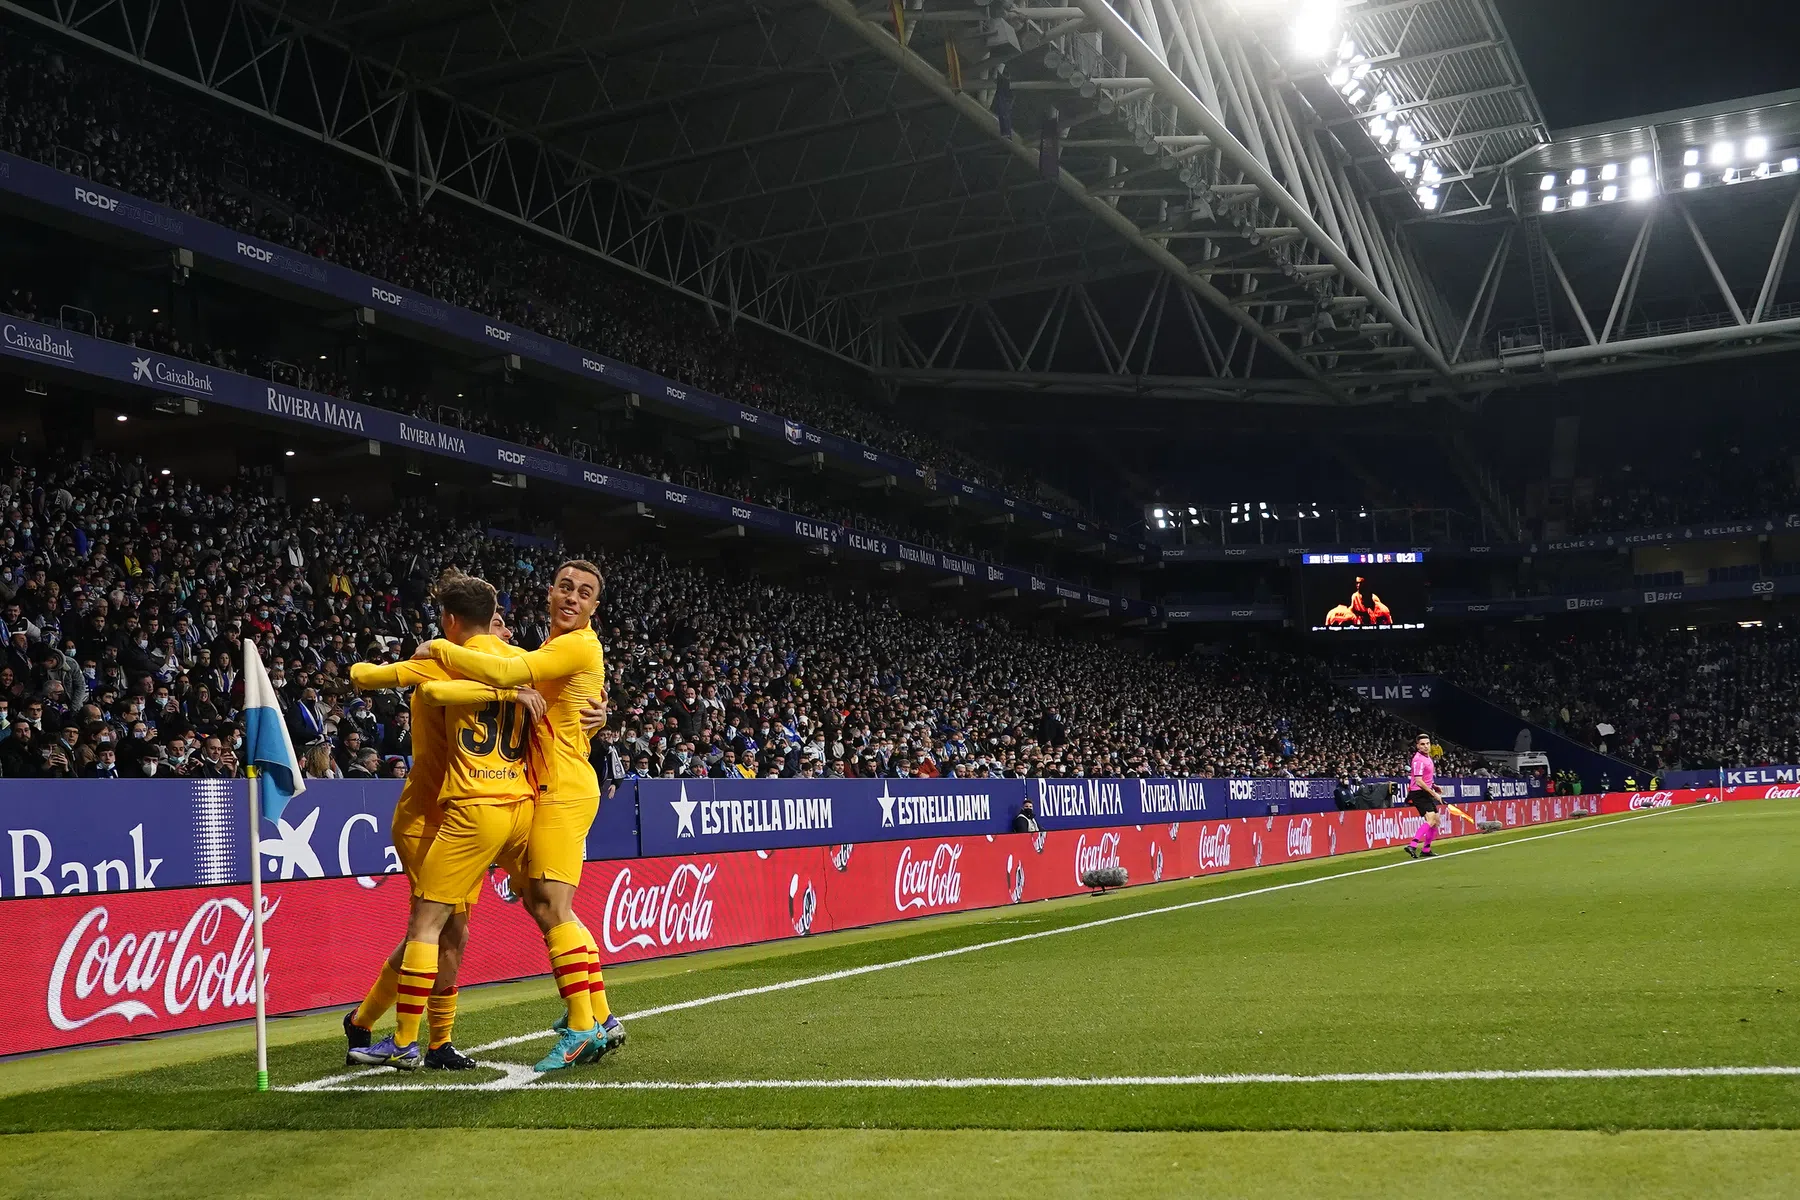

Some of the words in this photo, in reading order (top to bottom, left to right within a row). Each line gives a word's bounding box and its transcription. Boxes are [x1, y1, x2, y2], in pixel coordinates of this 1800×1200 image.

[3, 324, 74, 359] CaixaBank
[156, 363, 213, 392] CaixaBank
[267, 387, 321, 422] RIVIERA
[323, 401, 364, 432] MAYA
[400, 422, 437, 447] RIVIERA
[438, 432, 466, 454] MAYA
[795, 521, 829, 541] KELME
[848, 534, 880, 553] KELME
[1549, 540, 1585, 550] KELME
[1625, 533, 1663, 543] KELME
[1704, 525, 1743, 536] KELME
[1352, 685, 1413, 699] ELME
[469, 766, 507, 780] unicef
[1728, 769, 1800, 784] KELM
[897, 795, 956, 825] ESTRELLA
[956, 794, 991, 822] DAMM
[1038, 778, 1087, 816] RIVIERA
[1088, 779, 1123, 816] MAYA
[1140, 778, 1179, 813] RIVIERA
[1178, 779, 1206, 812] MAYA
[700, 800, 783, 835] ESTRELLA
[784, 798, 833, 830] DAMM
[0, 822, 164, 898] Bank
[895, 843, 964, 912] Coca-Cola
[603, 863, 718, 954] Coca-Cola
[48, 896, 282, 1031] Coca-Cola
